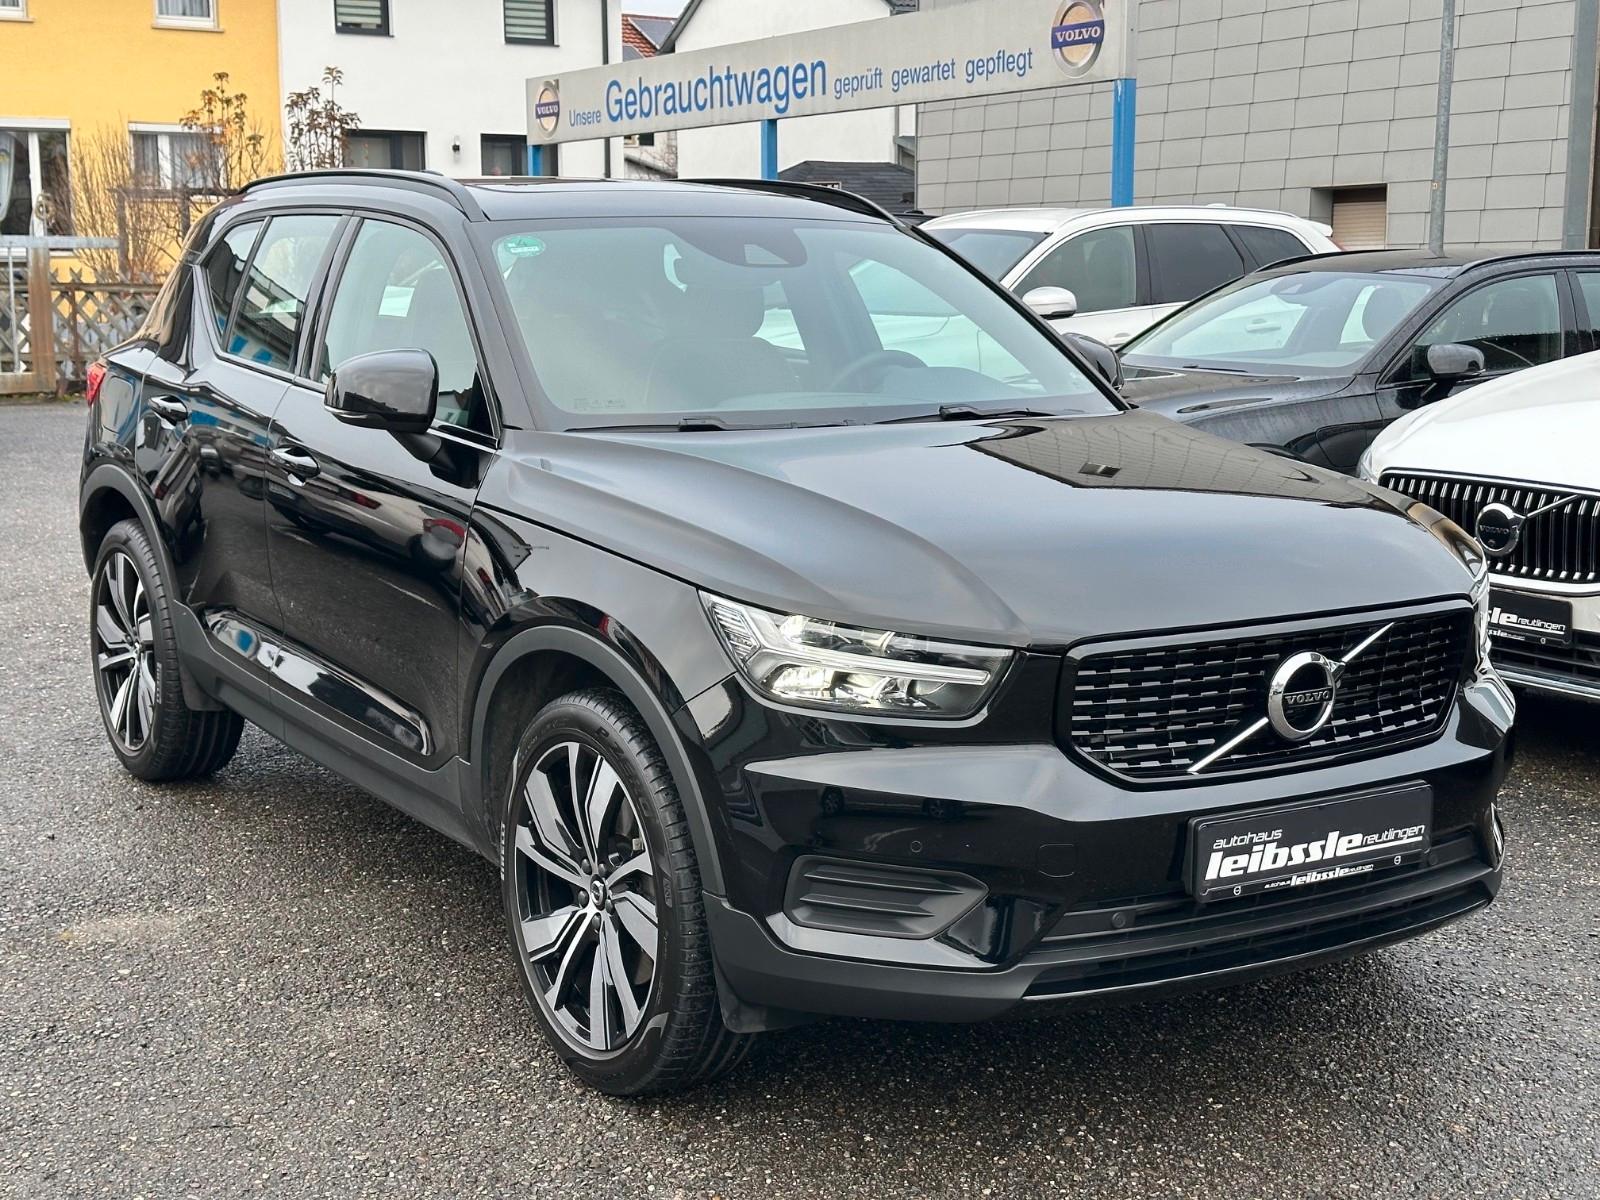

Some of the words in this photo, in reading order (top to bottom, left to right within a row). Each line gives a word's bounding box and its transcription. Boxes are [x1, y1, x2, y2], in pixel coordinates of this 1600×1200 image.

[1055, 25, 1101, 42] VOLVO
[569, 109, 601, 127] Unsere
[606, 60, 827, 122] Gebrauchtwagen
[834, 68, 883, 99] geprüft
[891, 58, 956, 92] gewartet
[965, 48, 1033, 83] gepflegt
[536, 103, 558, 115] VOLVO
[1517, 616, 1566, 631] reutlingen
[1285, 690, 1330, 704] VOLVO
[1213, 828, 1283, 849] autohaus
[1205, 830, 1364, 881] leibssle
[1363, 824, 1426, 846] reutlingen
